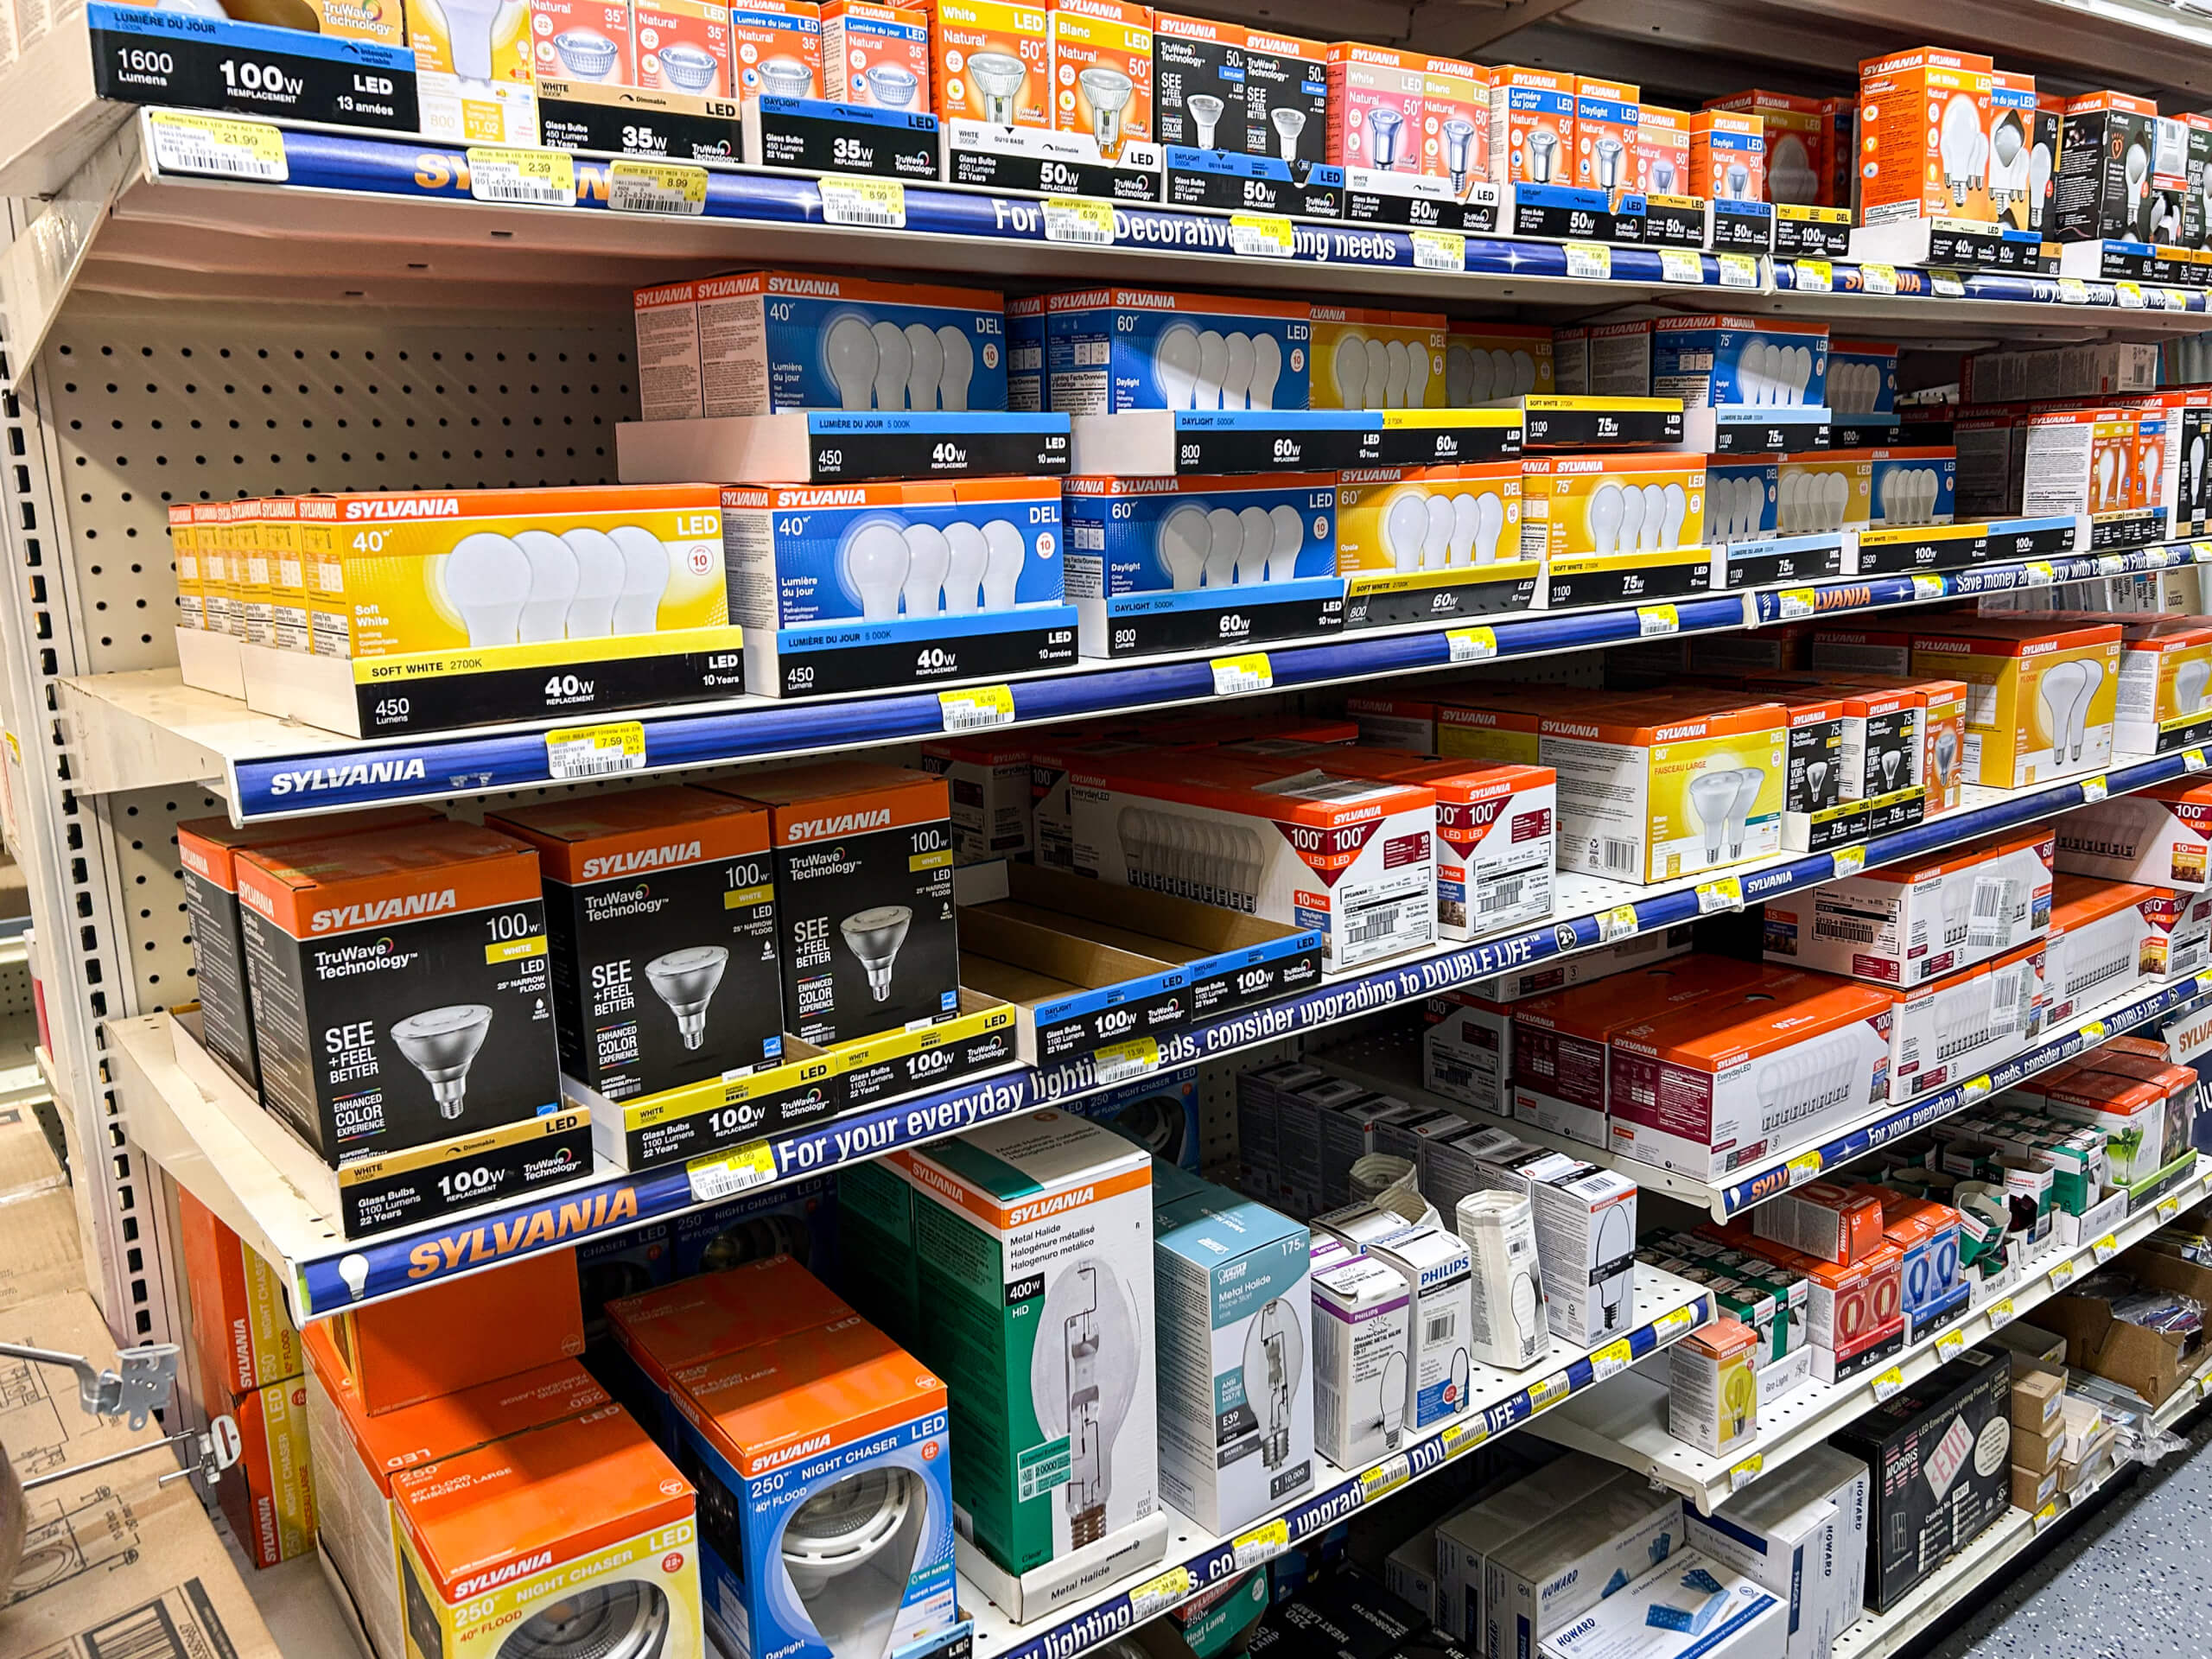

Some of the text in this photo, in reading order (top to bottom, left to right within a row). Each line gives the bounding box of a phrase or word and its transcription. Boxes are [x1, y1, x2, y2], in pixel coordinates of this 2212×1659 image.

[113, 13, 215, 34] LUMIÈRE DU JOUR
[944, 7, 1042, 30] White LED
[944, 30, 986, 47] Natural
[1059, 23, 1090, 39] Blanc
[1160, 19, 1217, 40] SYLVANIA
[118, 48, 174, 73] 1600
[1351, 48, 1400, 67] SYLVANIA
[1863, 54, 1923, 77] SYLVANIA
[1928, 54, 1961, 68] SYLVANIA
[118, 71, 168, 86] Lumens
[353, 74, 393, 96] LED
[1161, 73, 1182, 90] SEE
[1513, 74, 1557, 88] SYLVANIA
[226, 87, 297, 104] REMPLACEMENT
[1582, 84, 1620, 100] SYLVANIA
[336, 95, 394, 116] 13 années
[705, 101, 736, 118] LED
[764, 98, 801, 111] DAYLIGHT
[1580, 105, 1638, 123] Daylight LED
[907, 115, 935, 130] LED
[223, 131, 259, 147] 21.99
[528, 162, 551, 175] 2.39
[1130, 152, 1154, 167] LED
[667, 177, 688, 189] 8.99
[1477, 189, 1494, 202] LED
[991, 199, 1039, 232] For
[1334, 232, 1397, 262] needs
[636, 286, 693, 307] SYLVANIA
[768, 276, 841, 297] SYLVANIA
[1048, 291, 1110, 310] SYLVANIA
[1116, 292, 1176, 308] SYLVANIA
[976, 316, 1002, 335] DEL
[1287, 325, 1308, 340] LED
[819, 418, 883, 430] LUMIÈRE DU JOUR
[1181, 416, 1214, 427] DAYLIGHT
[1667, 415, 1681, 424] LED
[1045, 436, 1066, 449] LED
[1181, 444, 1200, 459] 800
[818, 449, 843, 466] 450
[1556, 460, 1604, 474] SYLVANIA
[1342, 469, 1402, 482] SYLVANIA
[778, 489, 866, 506] SYLVANIA
[345, 498, 459, 519] SYLVANIA
[1029, 506, 1060, 524] DEL
[676, 514, 719, 537] LED
[692, 554, 708, 568] 10
[781, 575, 817, 588] Lumière
[1956, 569, 2017, 593] Save money
[1814, 585, 1872, 612] LVANIA
[355, 604, 379, 616] Soft
[355, 615, 390, 627] White
[788, 633, 861, 648] LUMIÈRE DU JOUR
[372, 658, 483, 677] SOFT WHITE 2700K
[709, 653, 739, 670] LED
[702, 674, 740, 686] 10 Years
[375, 697, 410, 716] 450
[376, 712, 409, 726] Lumens
[601, 734, 622, 748] 7.59
[1655, 724, 1707, 741] SYLVANIA
[270, 757, 427, 796] SYLVANIA
[1654, 761, 1707, 775] FAISCEAU LARGE
[1333, 804, 1382, 825] SYLVANIA
[788, 808, 892, 842] SYLVANIA
[582, 840, 702, 880] SYLVANIA
[789, 852, 841, 869] TruWave
[1333, 853, 1350, 866] LED
[1747, 870, 1793, 893] SYLVANIA
[310, 888, 456, 932] SYLVANIA
[750, 925, 773, 937] FLOOD
[314, 940, 386, 968] TruWave
[591, 959, 633, 990] SEE
[1424, 948, 1494, 990] DOUBLE
[594, 998, 635, 1018] BETTER
[1206, 971, 1421, 1052] consider upgrading to
[325, 1020, 376, 1054] SEE
[597, 1036, 639, 1056] COLOR
[1158, 1033, 1203, 1067] eds,
[329, 1061, 380, 1084] BETTER
[334, 1093, 383, 1113] ENHANCED
[334, 1104, 383, 1127] COLOR
[545, 1116, 578, 1135] LED
[778, 1061, 1100, 1173] For your everyday lighti
[1868, 1093, 1956, 1147] For your everyday
[358, 1187, 416, 1208] Glass Bulbs
[1009, 1186, 1096, 1227] SYLVANIA
[407, 1185, 639, 1280] SYLVANIA
[1010, 1222, 1062, 1247] Metal Halide
[1420, 1255, 1470, 1286] PHILIPS
[1217, 1274, 1272, 1303] Metal Halide
[1012, 1304, 1030, 1319] HID
[1353, 1308, 1379, 1321] PHILIPS
[240, 1316, 253, 1390] SYLVANIA
[910, 1414, 945, 1442] LED
[1222, 1410, 1240, 1427] E39
[750, 1433, 831, 1473] SYLVANIA
[801, 1434, 901, 1483] NIGHT CHASER
[1935, 1422, 1968, 1486] EXIT
[1885, 1449, 1919, 1479] MORRIS
[1855, 1480, 1864, 1531] HOWARD
[1824, 1525, 1834, 1579] HOWARD
[453, 1551, 553, 1600] SYLVANIA
[1050, 1565, 1110, 1603] Metal Halide
[1541, 1568, 1579, 1601] HOWARD
[1043, 1603, 1130, 1659] lighting
[1556, 1617, 1597, 1647] HOWARD
